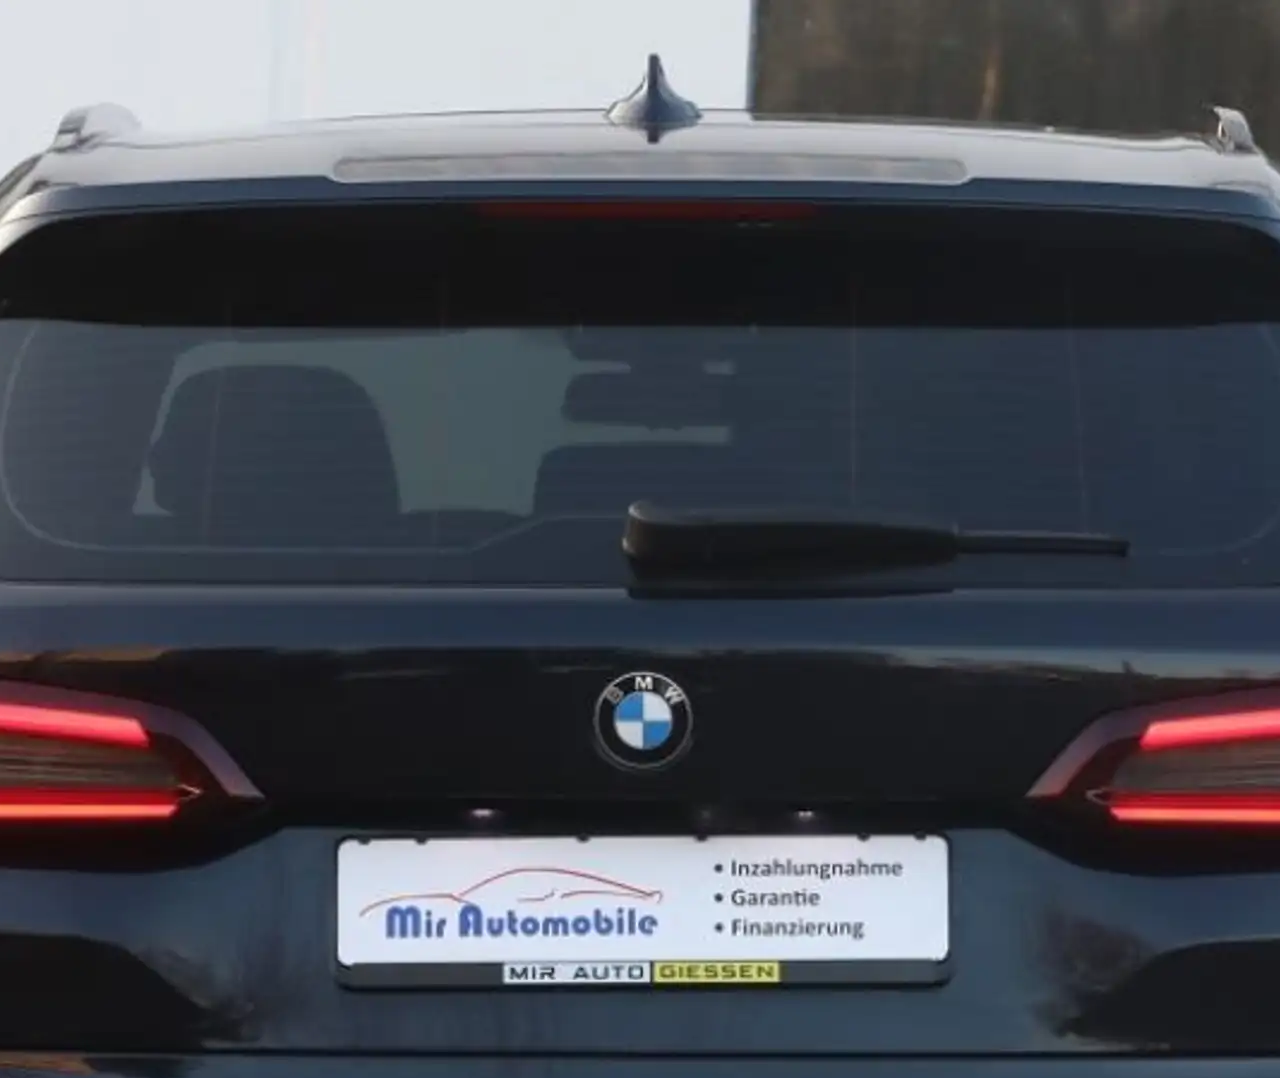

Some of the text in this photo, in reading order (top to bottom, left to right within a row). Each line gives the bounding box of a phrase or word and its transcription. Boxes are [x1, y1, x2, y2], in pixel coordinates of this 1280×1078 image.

[606, 676, 686, 704] BMW
[730, 858, 903, 880] Inzahlungnahme
[730, 889, 821, 906] Garantie
[385, 903, 659, 938] Mir Automobile
[730, 918, 865, 939] Finanzierung
[508, 963, 776, 981] MIR AUTO GIESSEN
